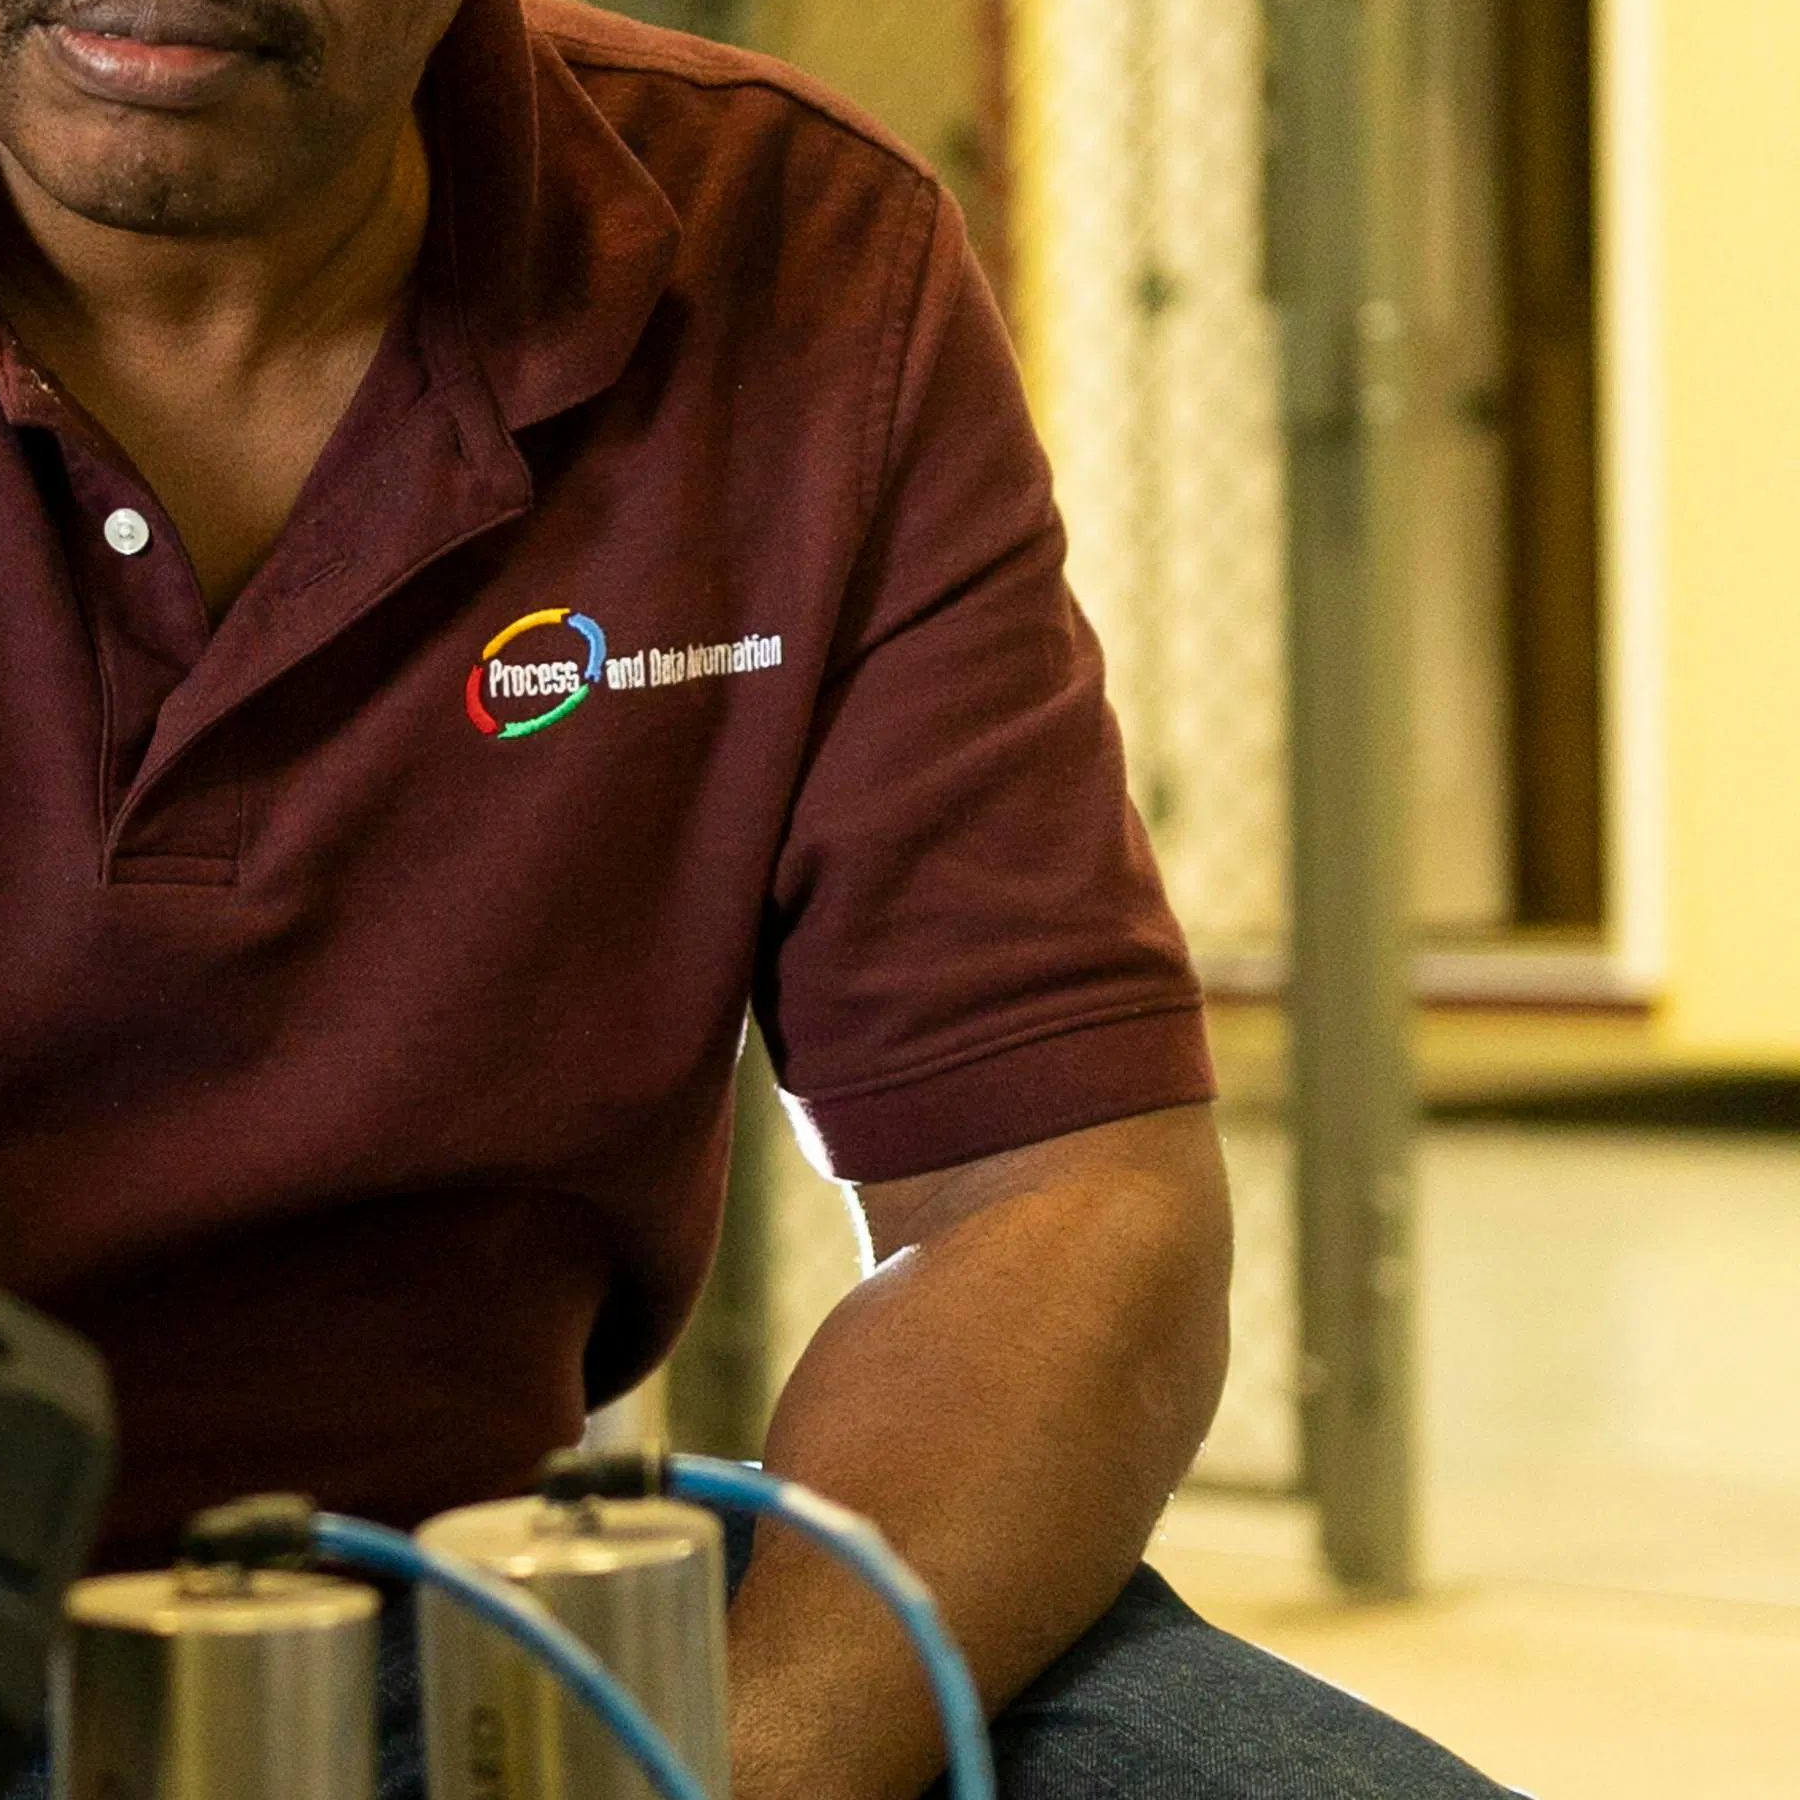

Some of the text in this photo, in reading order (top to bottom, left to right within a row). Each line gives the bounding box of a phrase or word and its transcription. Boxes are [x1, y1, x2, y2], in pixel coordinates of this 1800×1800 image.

[489, 659, 580, 698] Process
[606, 650, 646, 690] and
[649, 647, 686, 688] Data
